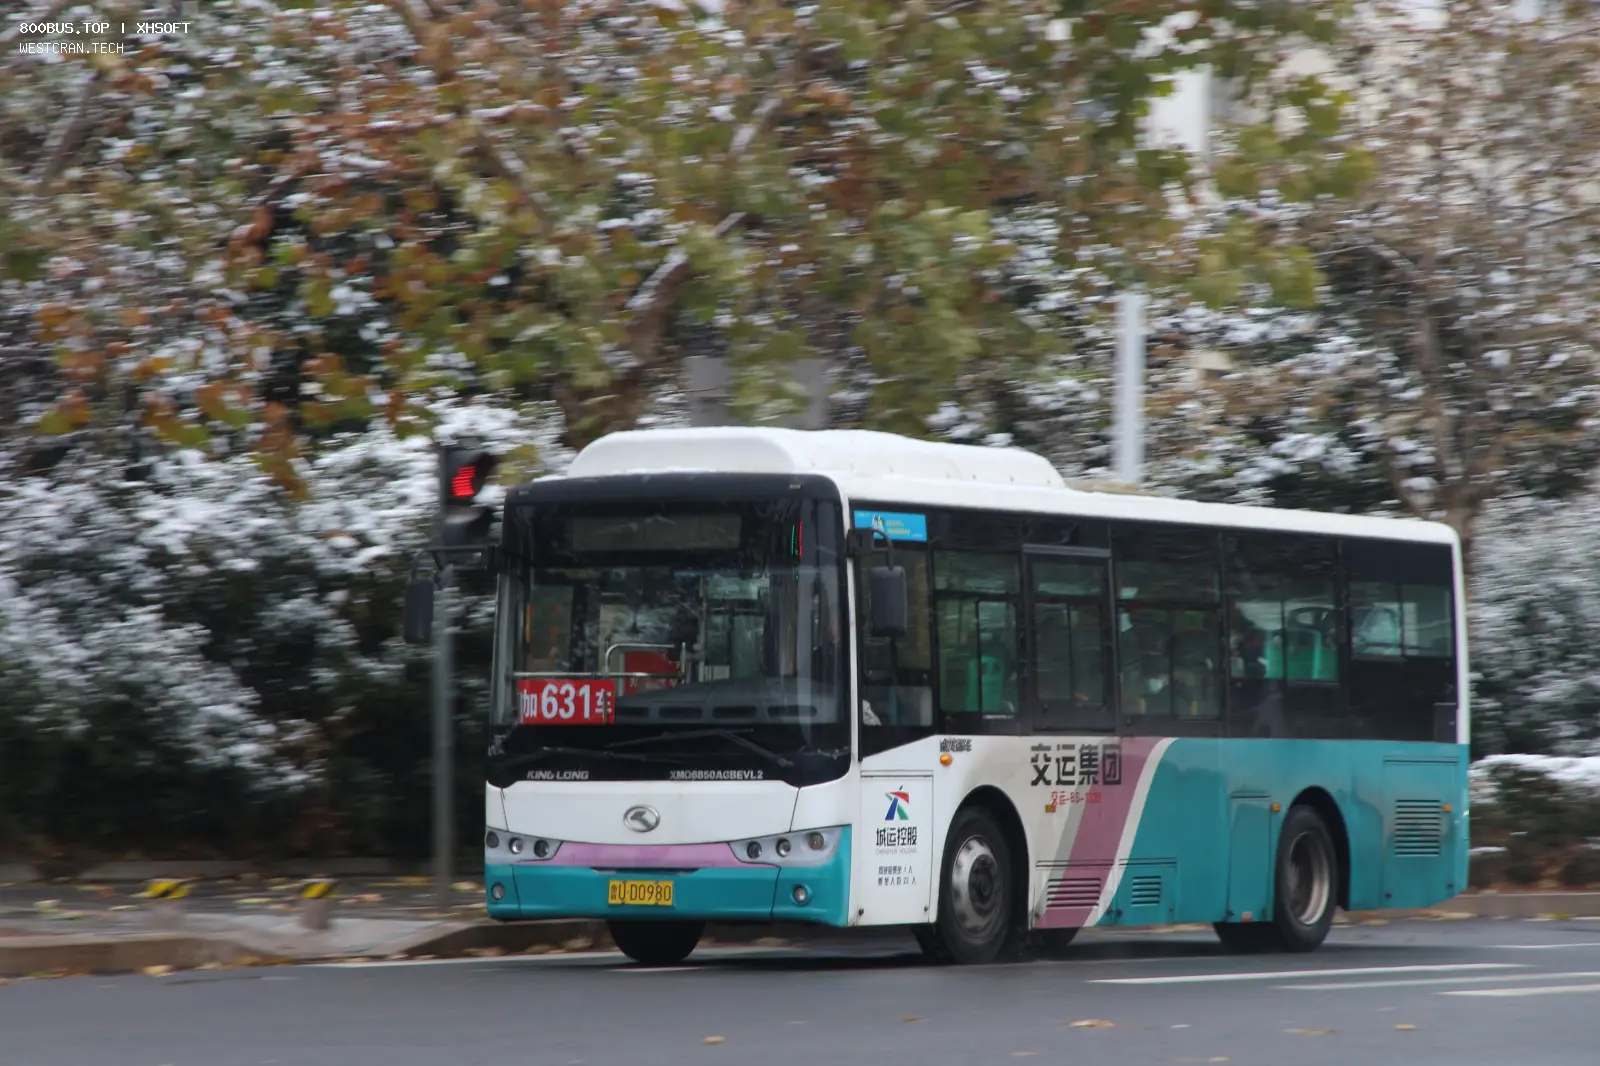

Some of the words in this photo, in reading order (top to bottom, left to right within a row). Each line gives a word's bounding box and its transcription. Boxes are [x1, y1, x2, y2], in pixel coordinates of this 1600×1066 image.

[526, 770, 555, 780] KING
[556, 770, 589, 780] LONG
[1030, 743, 1122, 787] 交运集团
[875, 826, 918, 847] 城运控股
